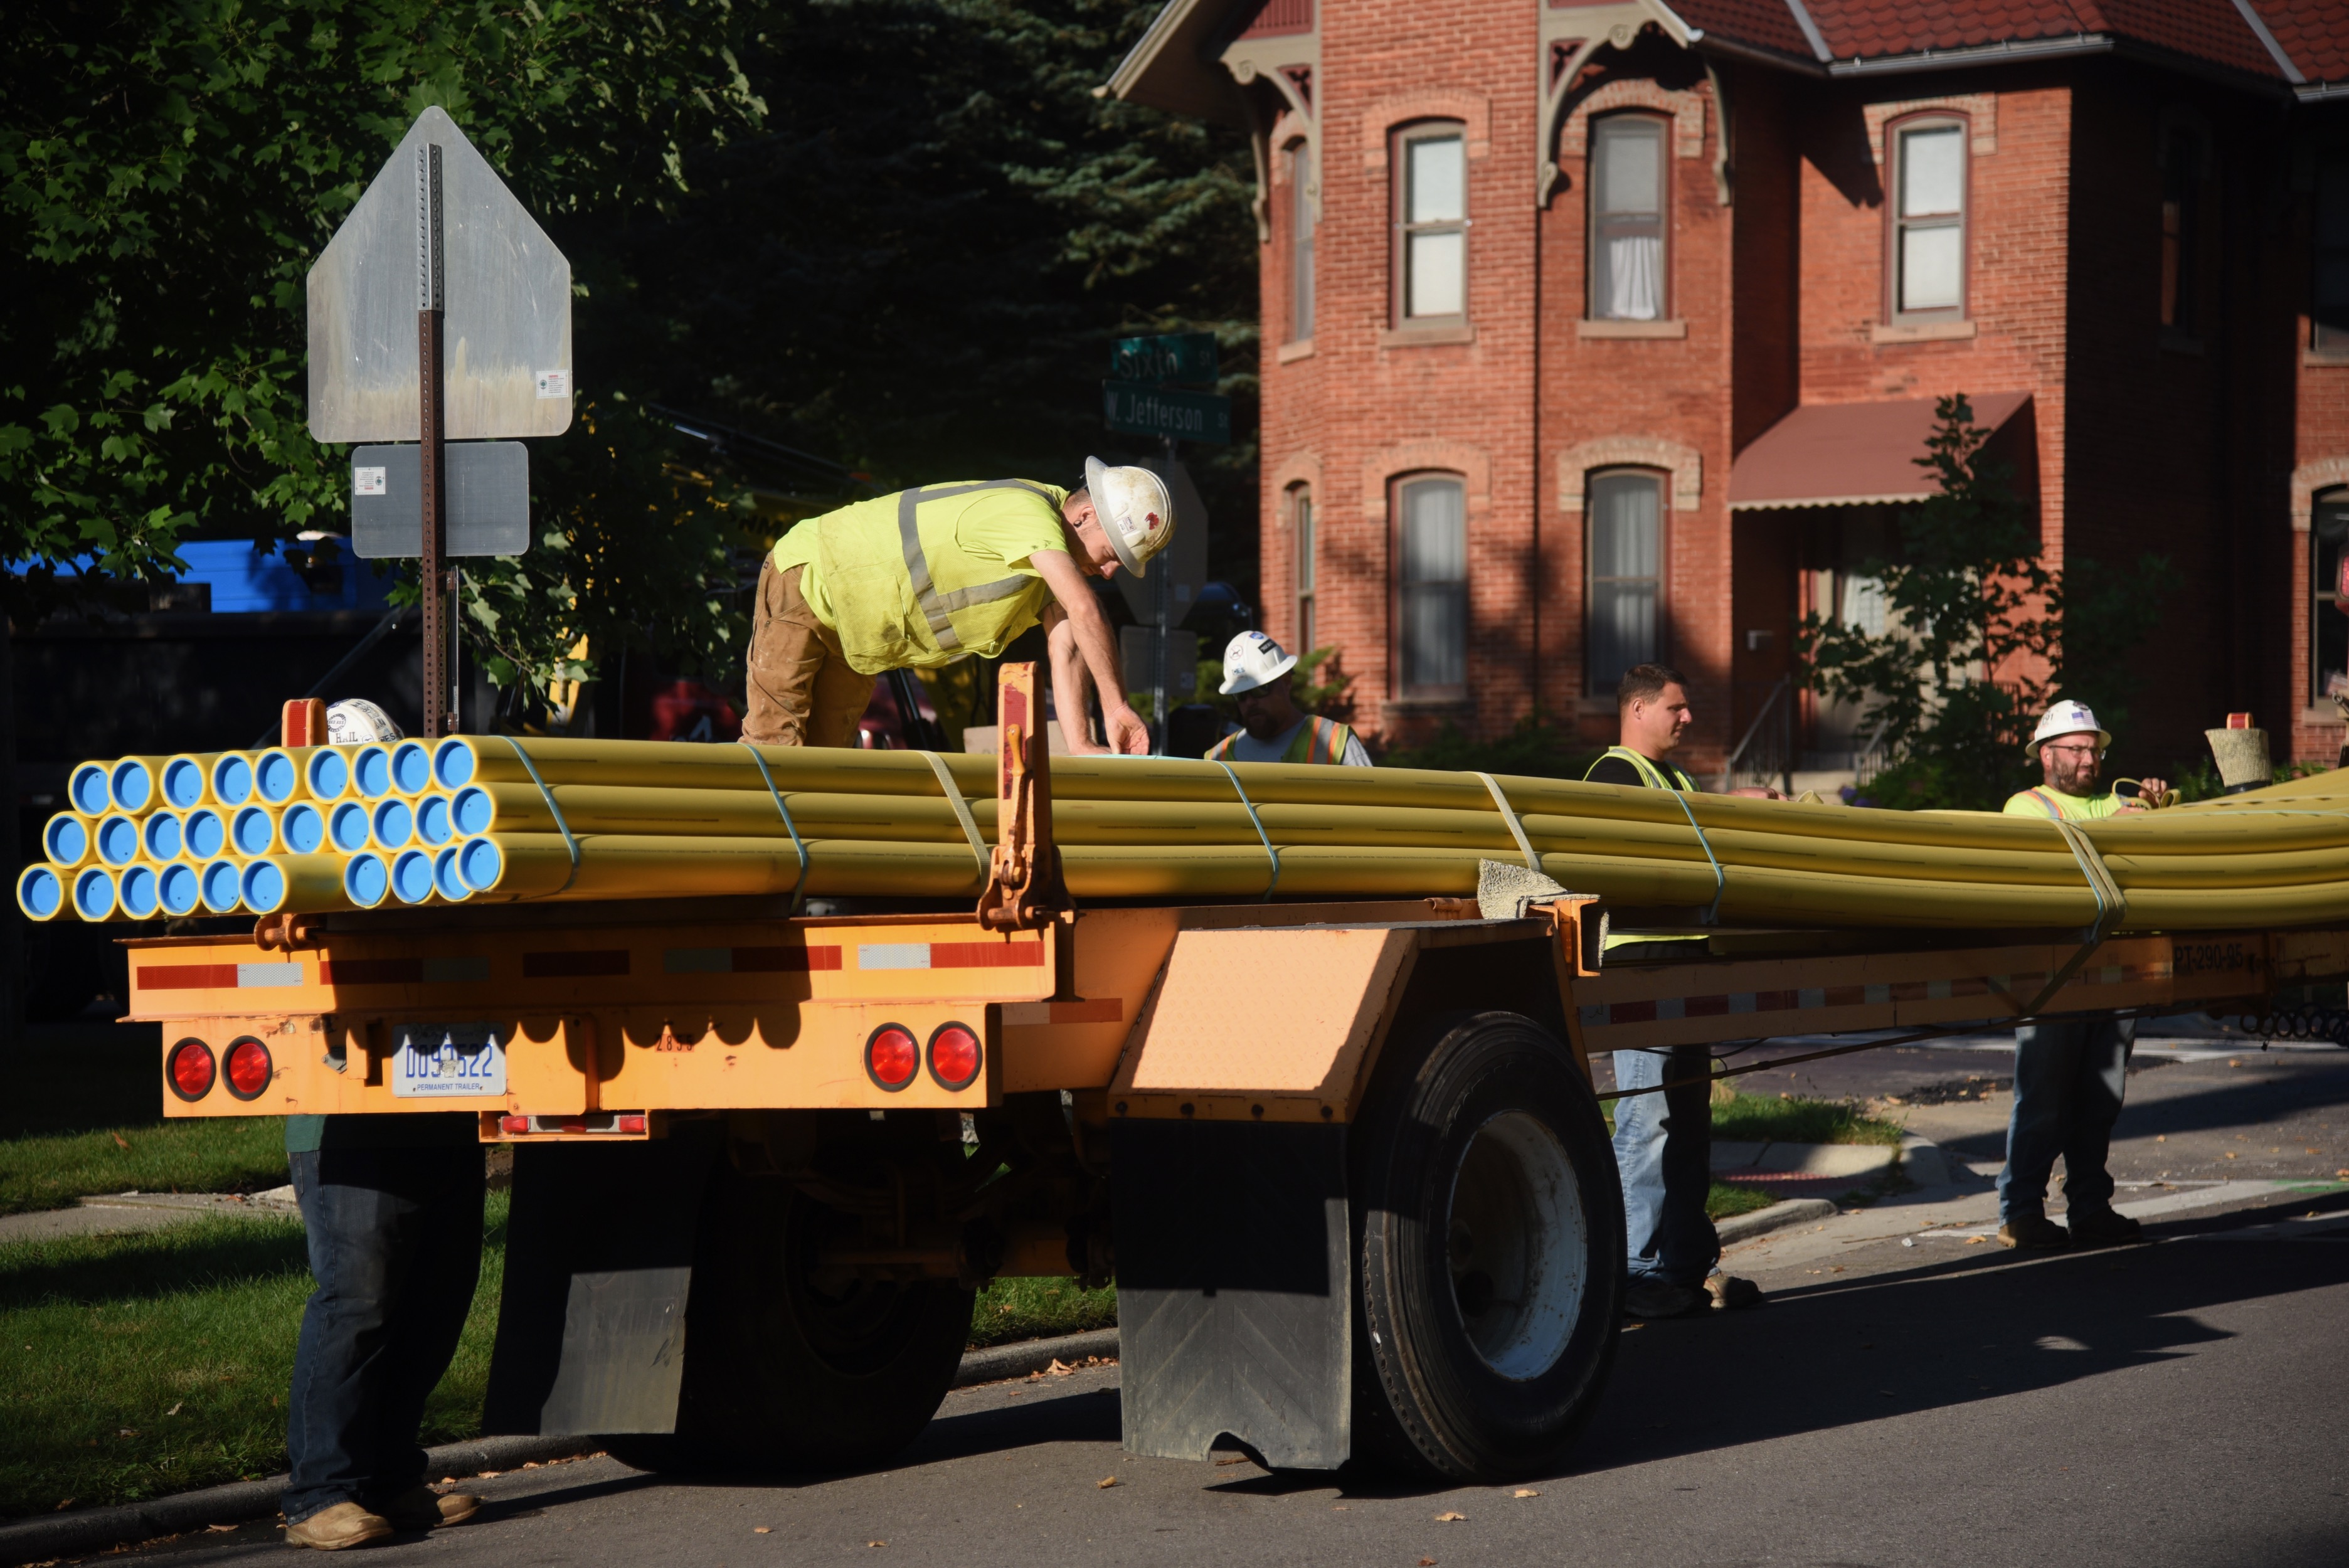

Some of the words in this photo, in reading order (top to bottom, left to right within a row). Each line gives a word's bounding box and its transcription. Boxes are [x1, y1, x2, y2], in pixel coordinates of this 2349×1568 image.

[1119, 347, 1179, 378] Sixth
[1199, 350, 1211, 366] St
[1106, 391, 1120, 422] W.
[1125, 393, 1203, 432] Jefferson
[1217, 413, 1229, 428] St
